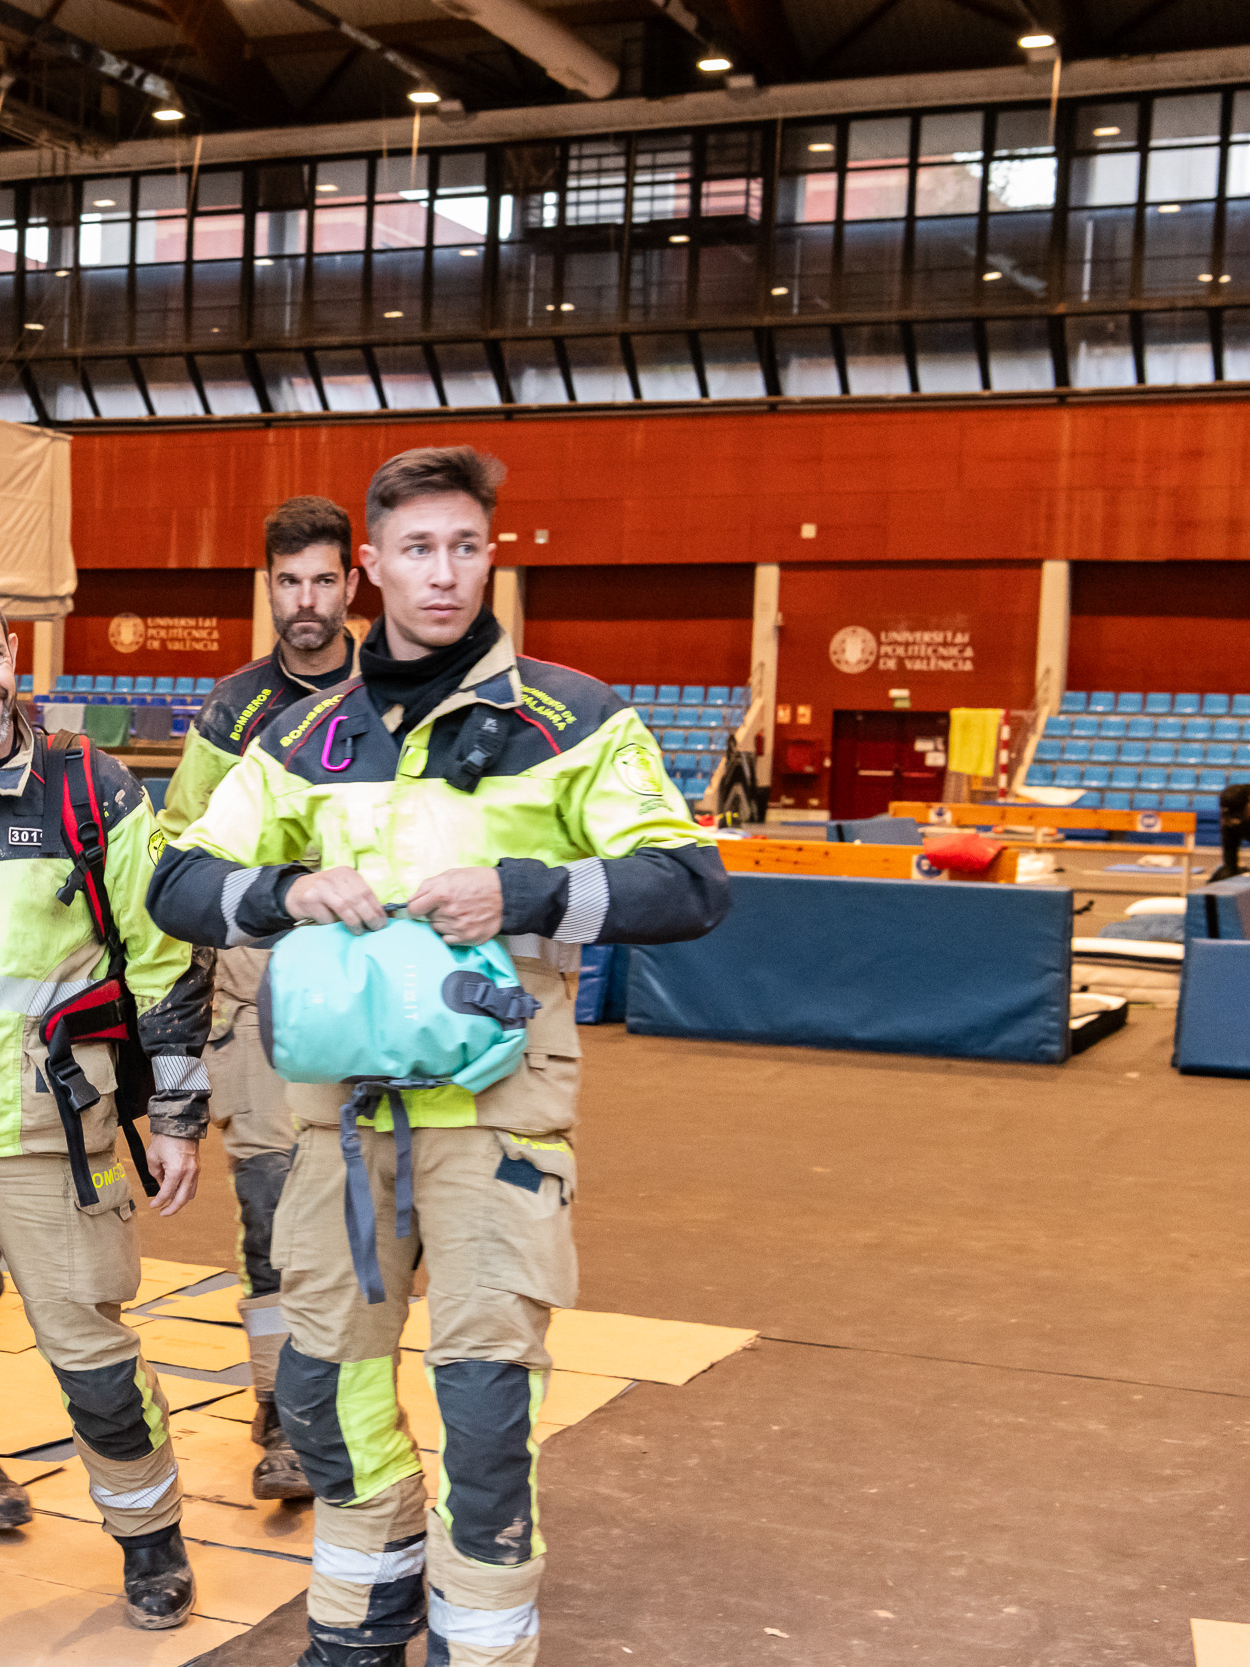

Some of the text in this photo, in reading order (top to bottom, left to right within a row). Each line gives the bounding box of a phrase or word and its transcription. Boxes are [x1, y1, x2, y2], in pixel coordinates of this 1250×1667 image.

[147, 617, 217, 627] UNIVERSITAT
[880, 630, 971, 644] UNIVERSITAT
[147, 640, 160, 650] DE
[878, 658, 897, 671] DE
[229, 688, 272, 741] BOMBEROS
[279, 694, 345, 748] BOMBERO
